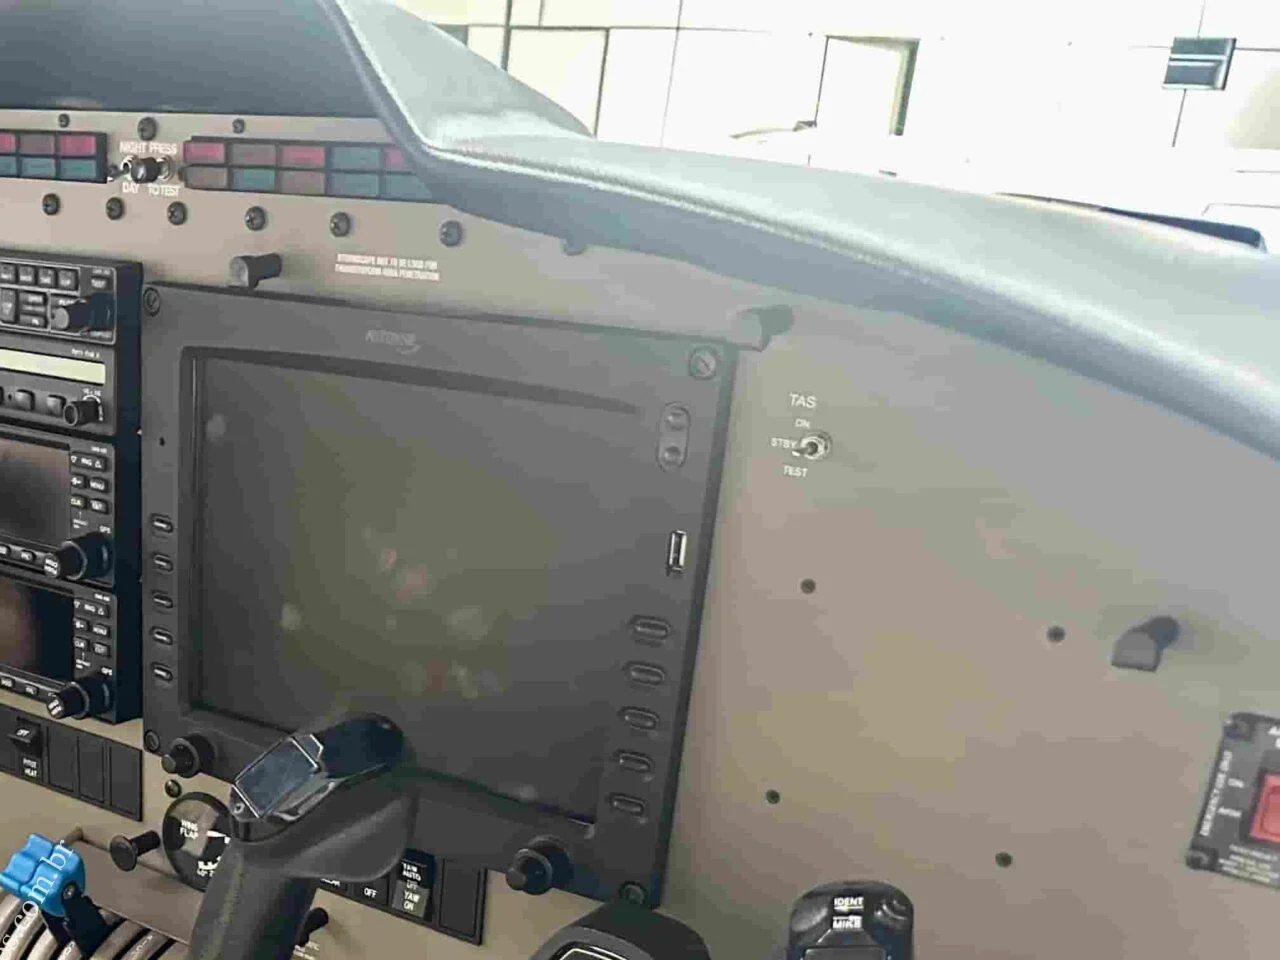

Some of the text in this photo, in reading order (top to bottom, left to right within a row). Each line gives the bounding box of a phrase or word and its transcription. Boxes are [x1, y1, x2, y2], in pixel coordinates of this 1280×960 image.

[120, 141, 178, 155] NIGHT PRESS
[122, 181, 140, 194] DAY
[789, 392, 817, 409] TAS
[783, 464, 809, 478] TEST
[180, 827, 199, 840] FLAP
[363, 887, 377, 898] OFF
[404, 891, 421, 903] YAW
[403, 901, 415, 911] ON
